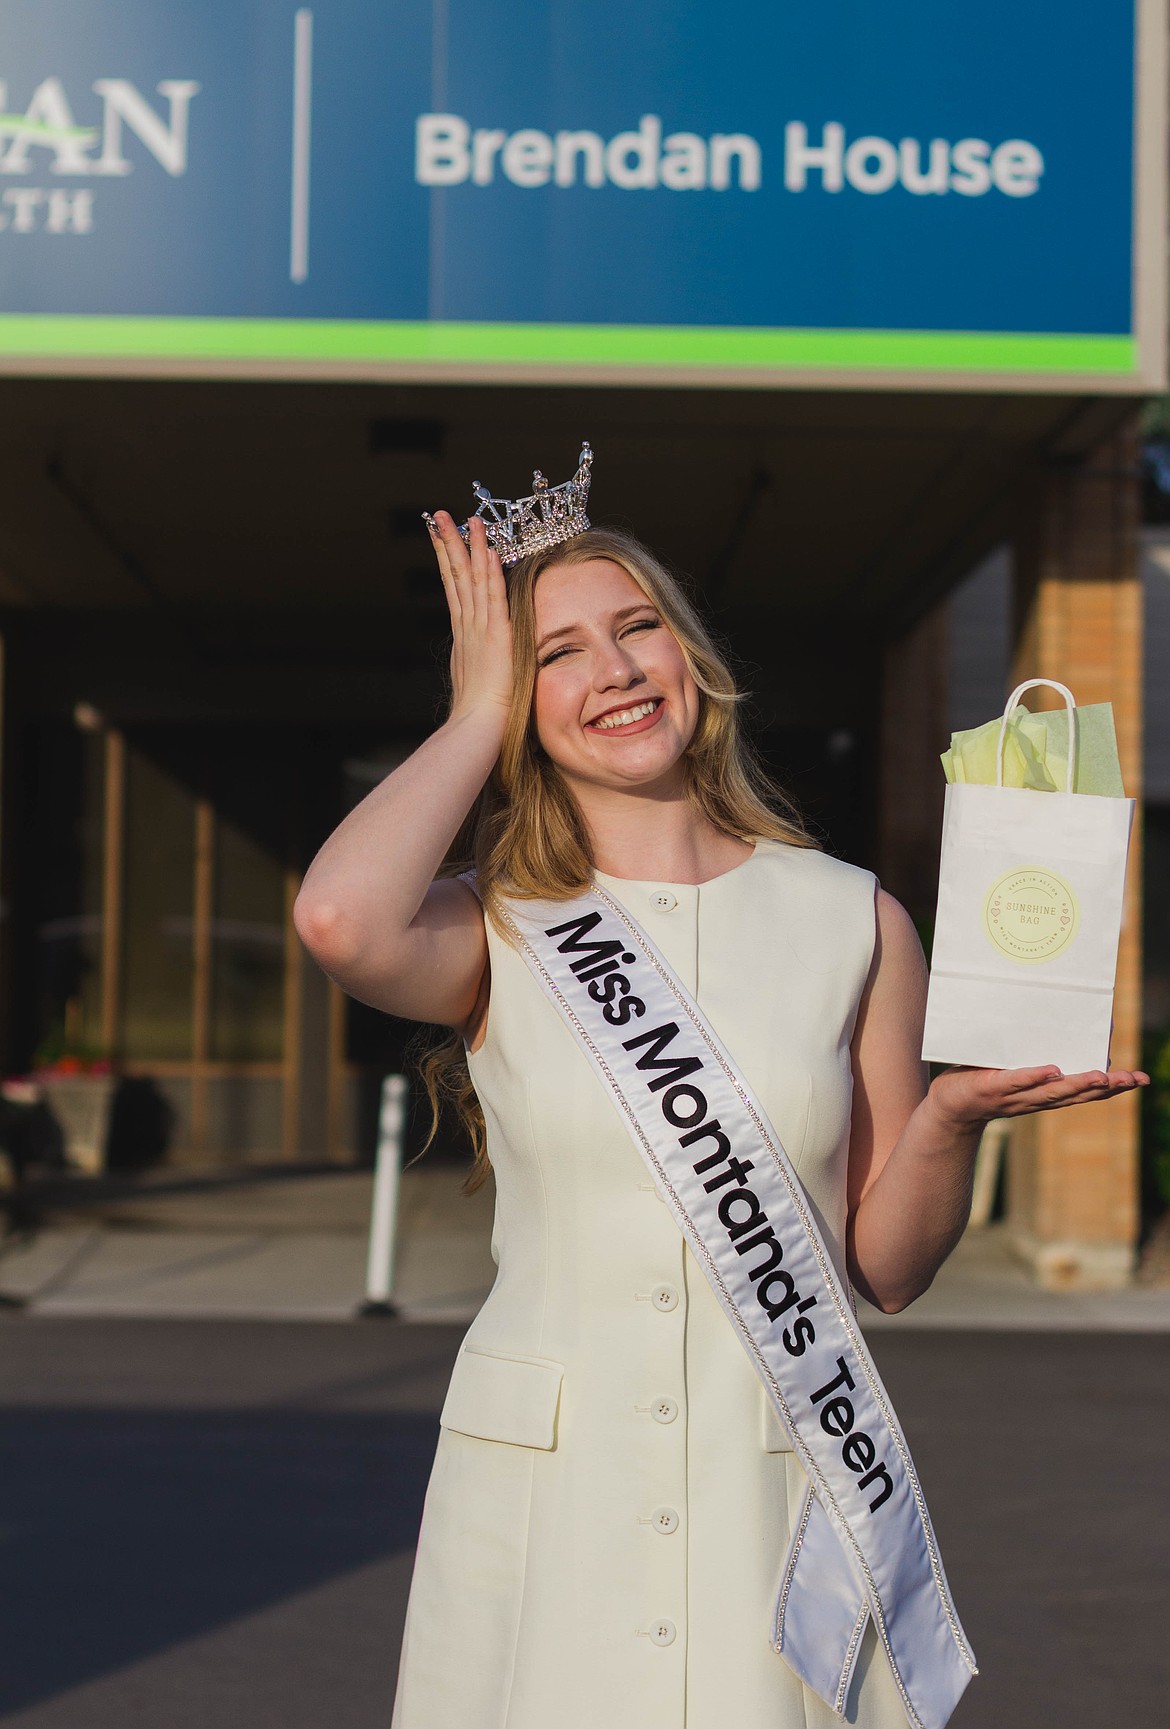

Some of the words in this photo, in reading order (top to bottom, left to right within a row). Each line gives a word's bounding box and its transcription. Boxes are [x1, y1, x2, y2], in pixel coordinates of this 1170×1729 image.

[0, 76, 199, 177] AN
[415, 114, 759, 190] Brendan
[785, 121, 1043, 197] House
[0, 187, 93, 235] TH
[1006, 902, 1057, 916] SUNSHINE
[1020, 915, 1040, 925] BAG
[544, 911, 647, 1026] Miss
[621, 1021, 818, 1357] Montana's
[809, 1355, 894, 1514] Teen
